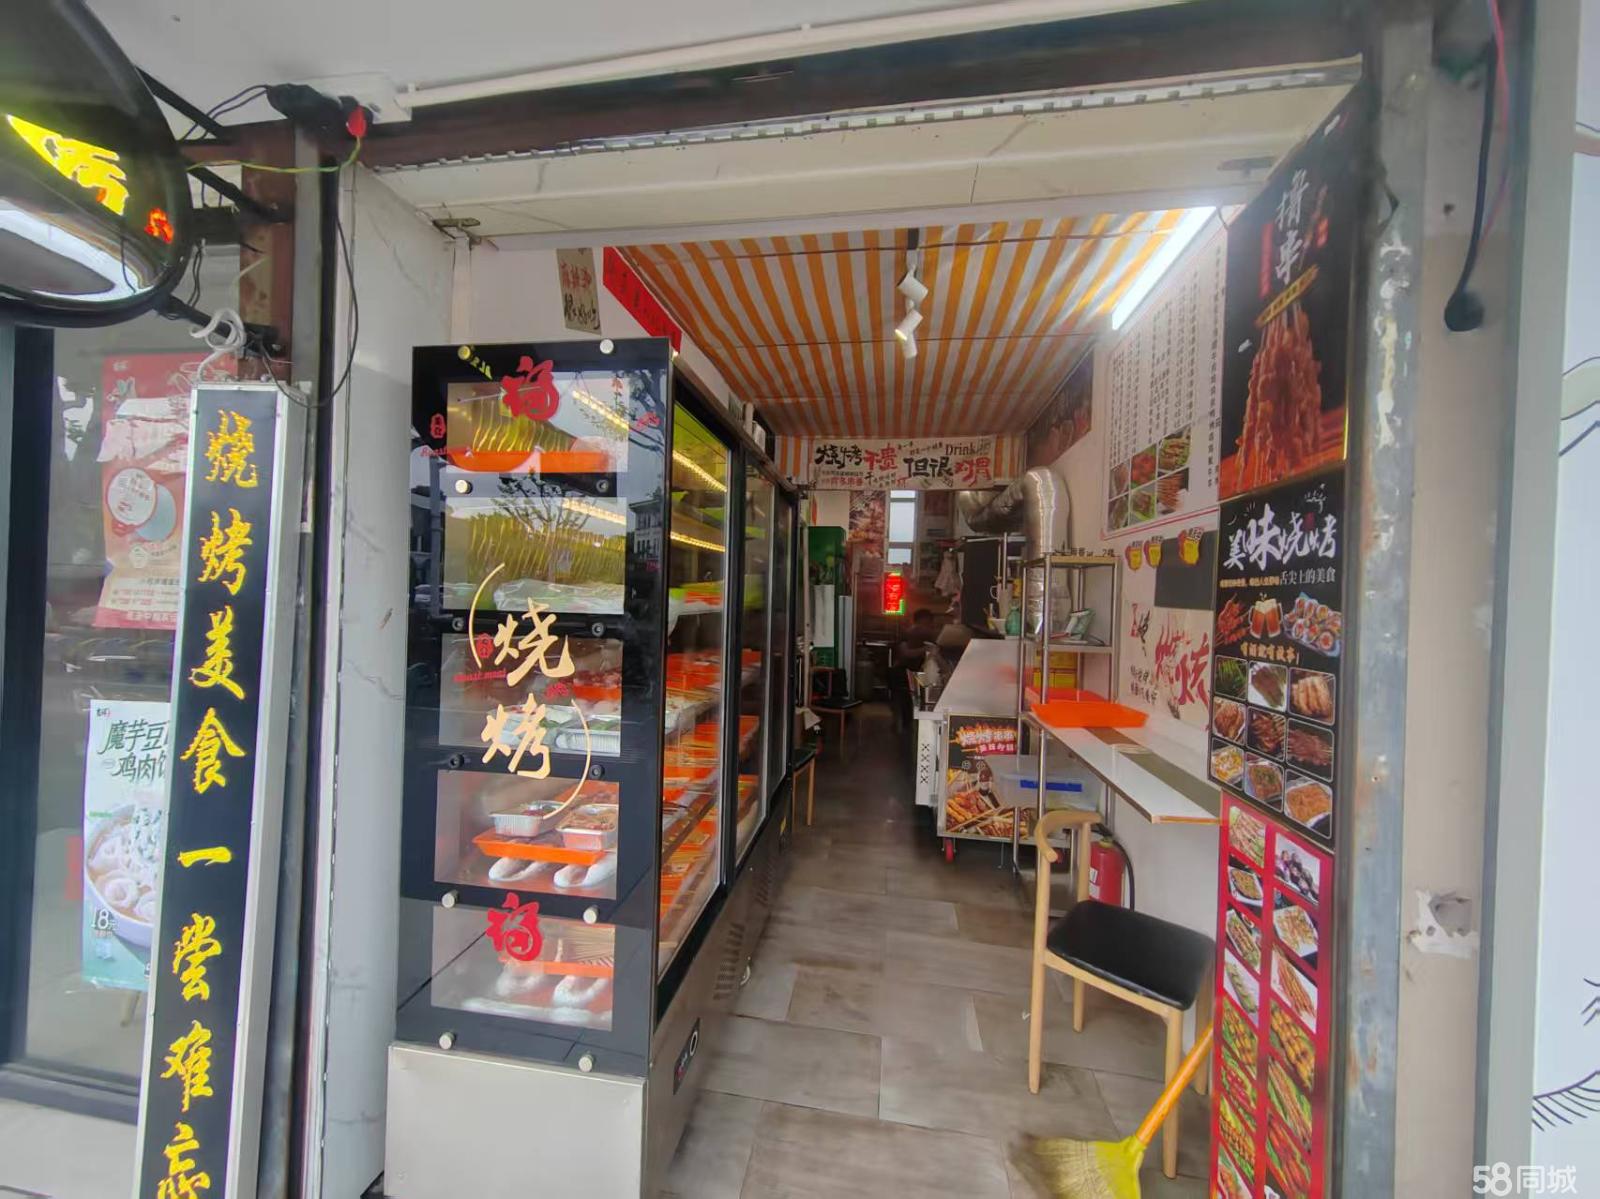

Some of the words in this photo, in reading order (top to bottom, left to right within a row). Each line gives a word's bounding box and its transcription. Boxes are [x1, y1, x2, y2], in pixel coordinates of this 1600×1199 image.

[501, 355, 560, 421] 福
[944, 442, 977, 457] Drink
[1223, 503, 1337, 571] 美味烧烤
[1280, 566, 1337, 586] 舌尖上的美食
[481, 597, 576, 780] 烧烤
[97, 717, 170, 755] 魔芋豆
[485, 891, 544, 962] 福
